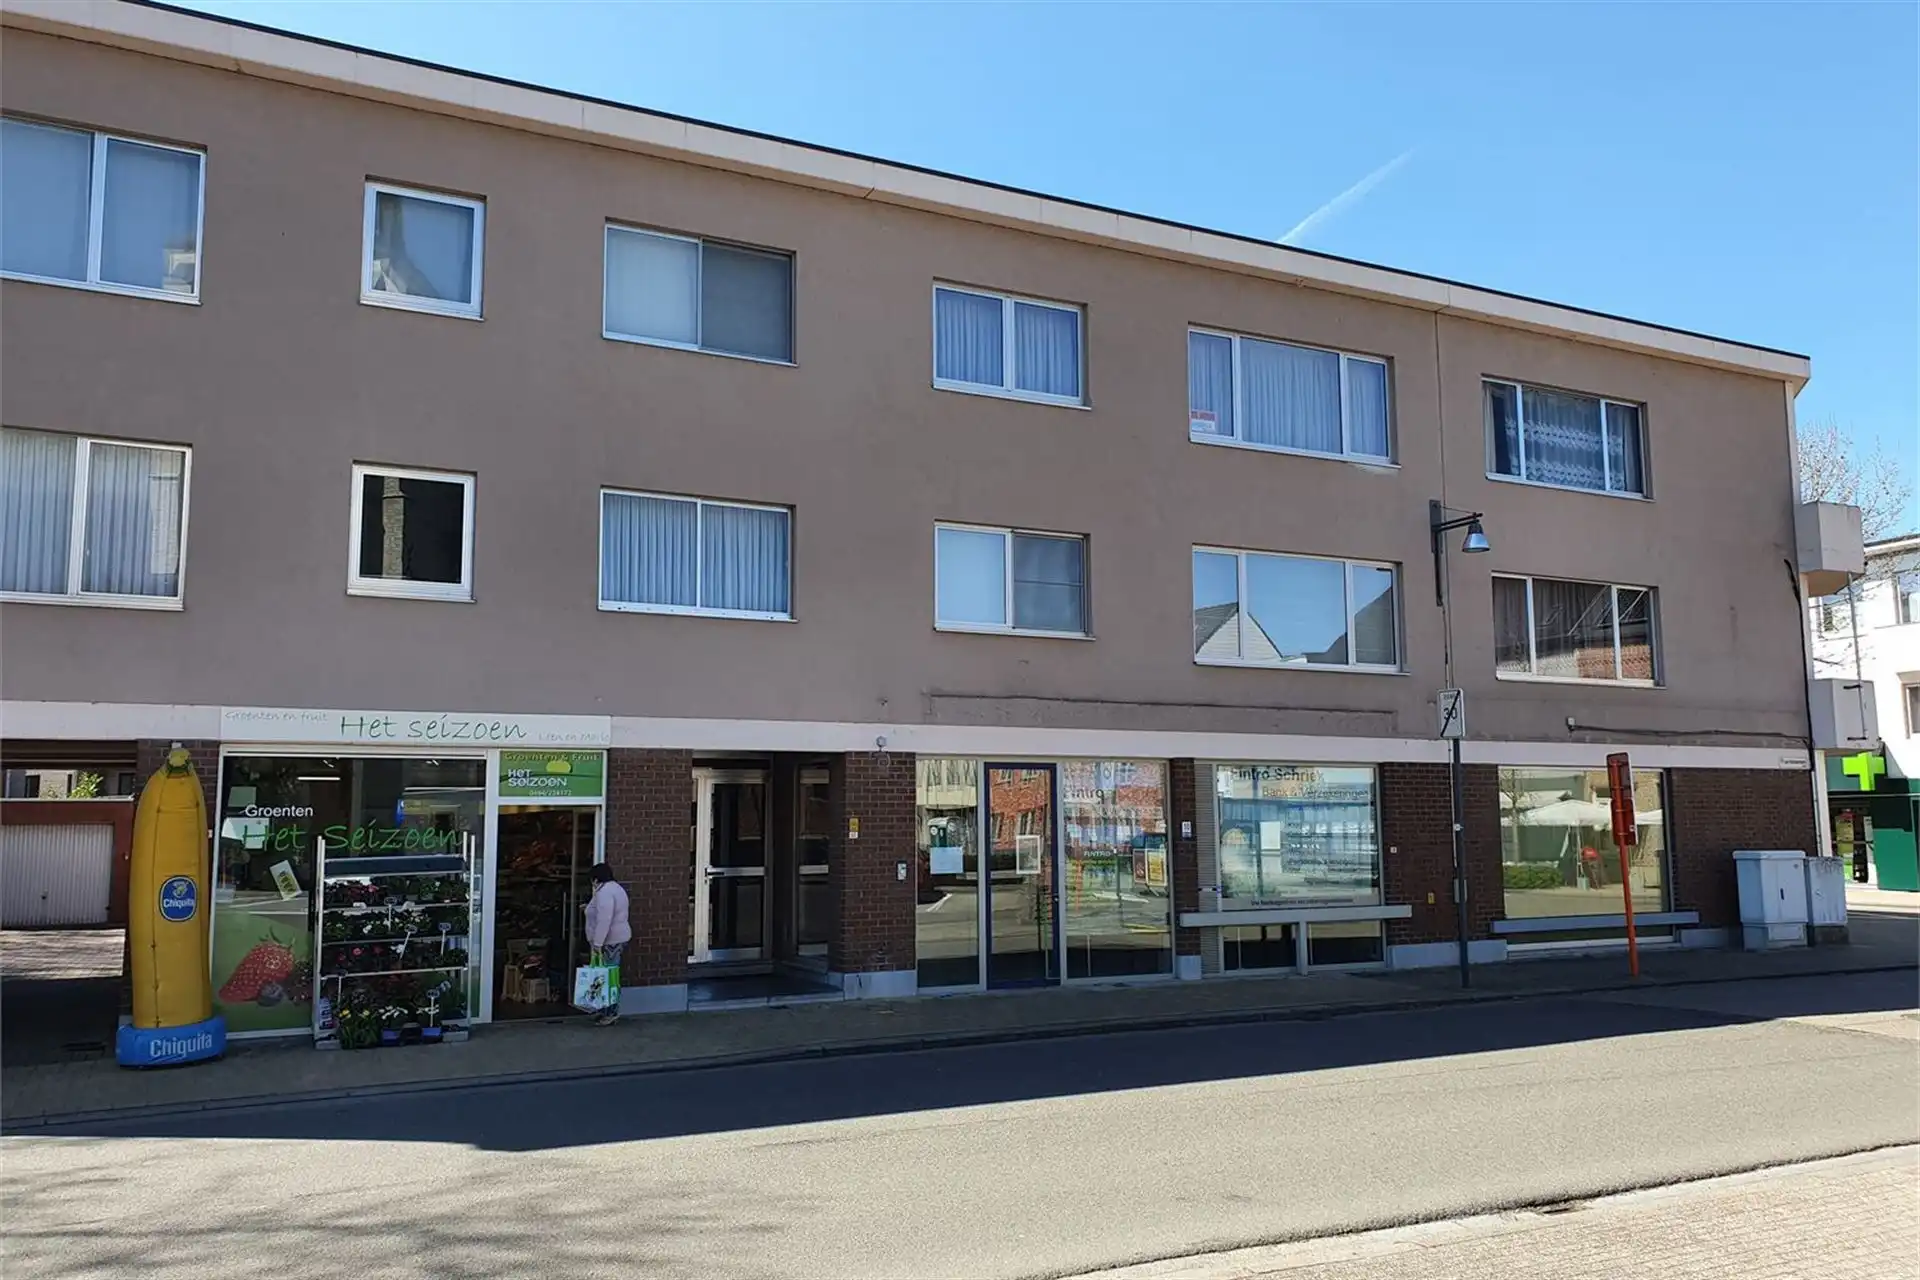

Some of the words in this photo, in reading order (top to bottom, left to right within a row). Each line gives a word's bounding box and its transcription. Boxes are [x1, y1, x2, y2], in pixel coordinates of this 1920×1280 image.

[1443, 707, 1458, 720] 30
[340, 715, 399, 738] Het
[407, 714, 527, 740] seizoen
[1262, 786, 1287, 797] Bank
[244, 803, 314, 818] Groenten
[242, 823, 306, 851] Het
[321, 818, 464, 850] Seizoen
[163, 897, 194, 910] Chiquita
[150, 1032, 213, 1058] Chiquita
